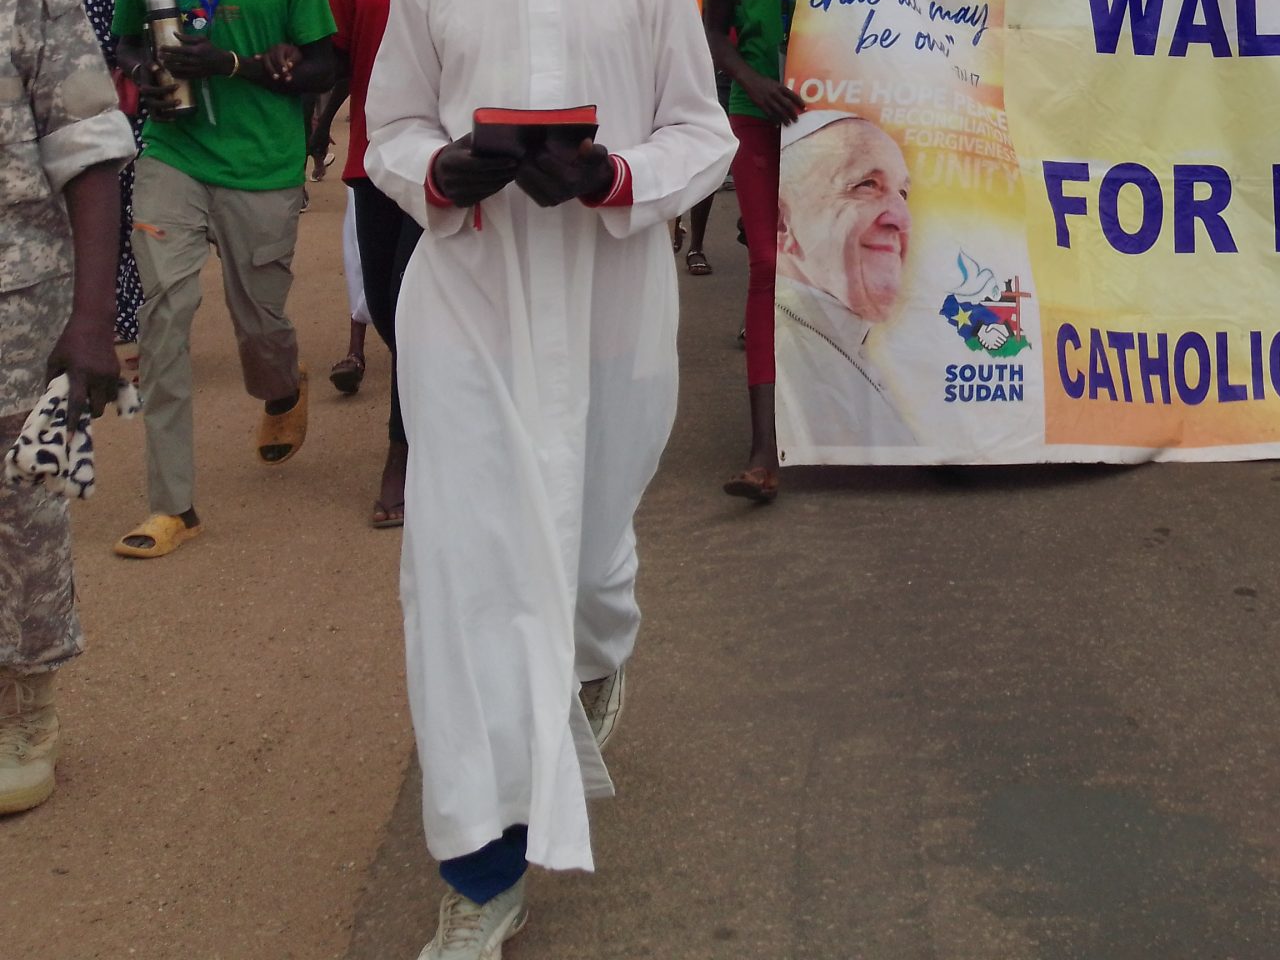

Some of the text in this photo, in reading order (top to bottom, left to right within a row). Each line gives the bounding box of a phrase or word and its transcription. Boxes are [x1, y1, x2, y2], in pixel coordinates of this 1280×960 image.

[855, 9, 901, 55] be
[929, 1, 989, 46] may
[869, 80, 948, 110] HOPE
[953, 92, 1008, 131] PEACE
[903, 127, 1018, 163] FORGIVENESS
[915, 151, 1022, 194] UNITY
[1042, 159, 1239, 254] FOR
[944, 364, 1024, 383] SOUTH
[944, 383, 1024, 402] SUDAN
